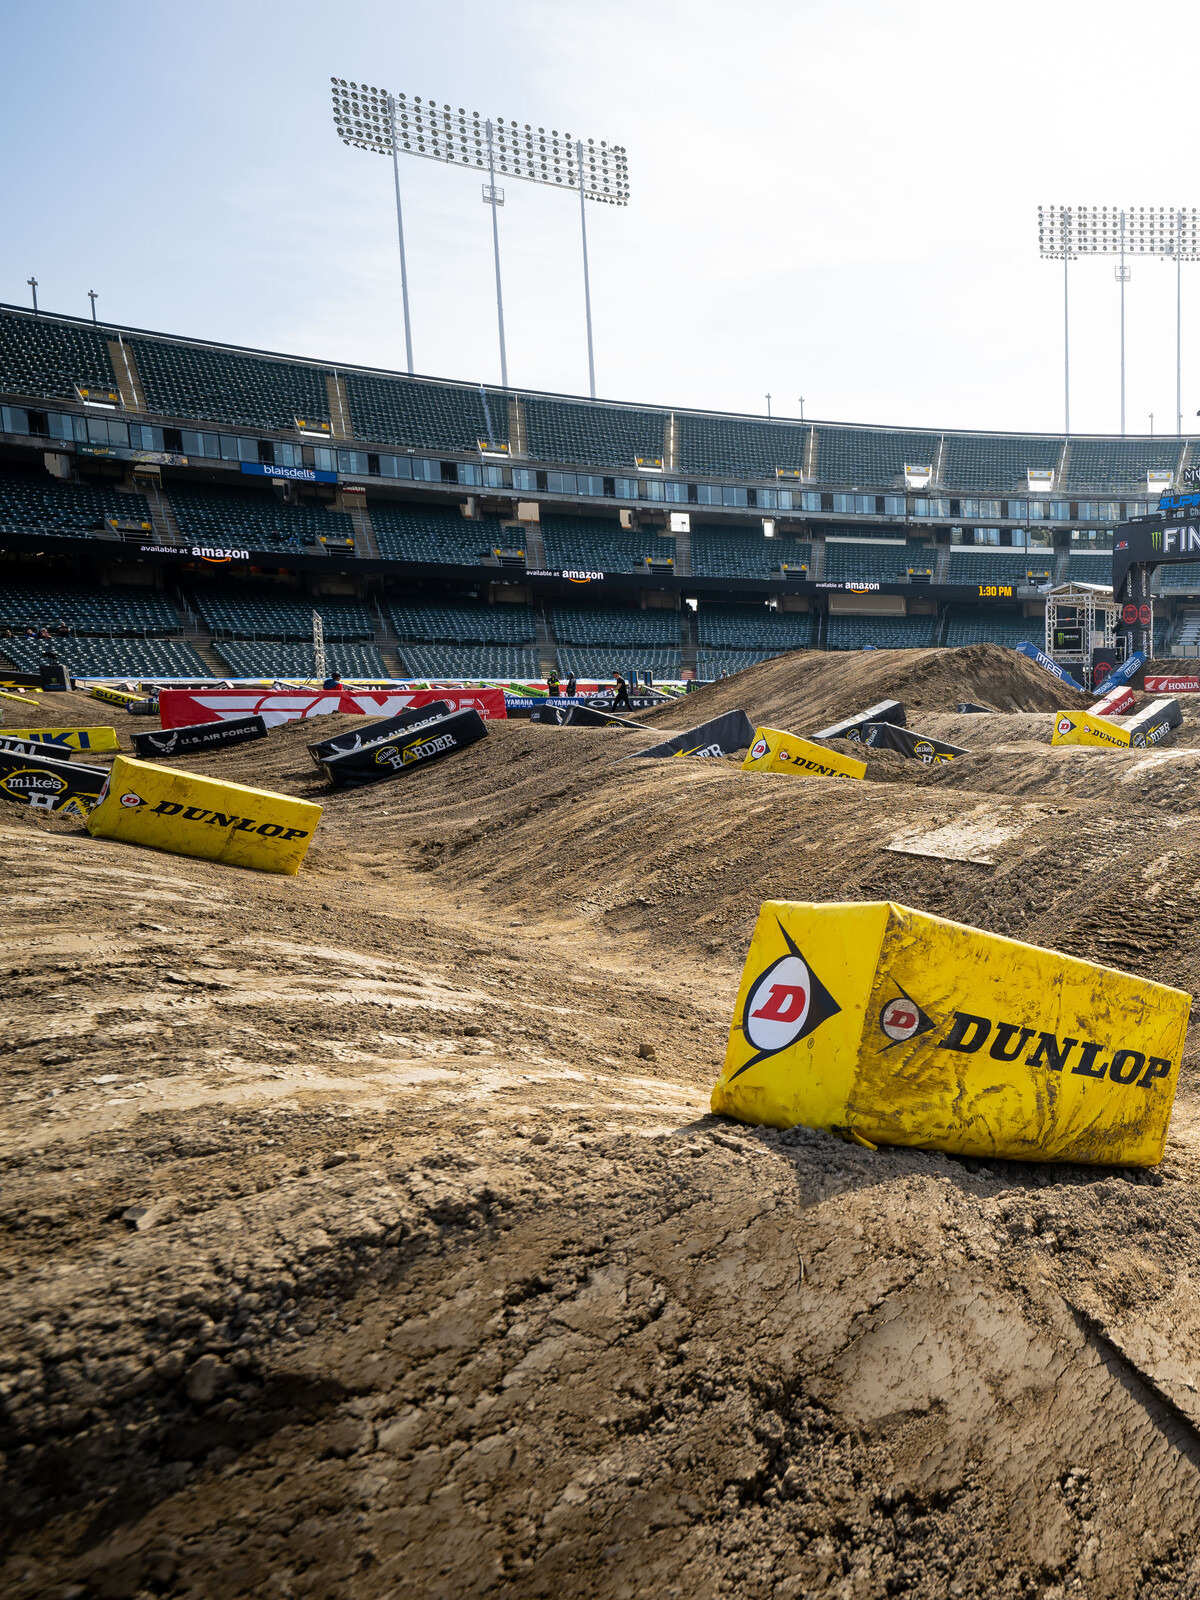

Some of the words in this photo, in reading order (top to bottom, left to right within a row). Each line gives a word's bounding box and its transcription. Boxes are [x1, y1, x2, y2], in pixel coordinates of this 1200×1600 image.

[140, 545, 177, 554] available
[191, 547, 249, 560] amazon
[562, 570, 604, 580] amazon
[845, 582, 880, 590] amazon
[978, 586, 997, 596] 1:30
[998, 587, 1012, 597] PM
[1036, 652, 1062, 678] WPS
[1125, 659, 1142, 678] WPS
[1168, 682, 1200, 691] HONDA
[181, 737, 201, 745] U.S.
[202, 734, 221, 742] AIR
[222, 726, 258, 737] FORCE
[1092, 730, 1128, 748] DUNLOP
[388, 734, 458, 770] HARDER
[754, 744, 764, 754] D
[791, 756, 864, 779] DUNLO
[8, 776, 62, 790] mike's
[124, 796, 139, 804] D
[150, 800, 309, 841] DUNLOP
[751, 984, 806, 1023] D
[884, 1009, 916, 1029] D
[937, 1011, 1172, 1090] DUNLOP
